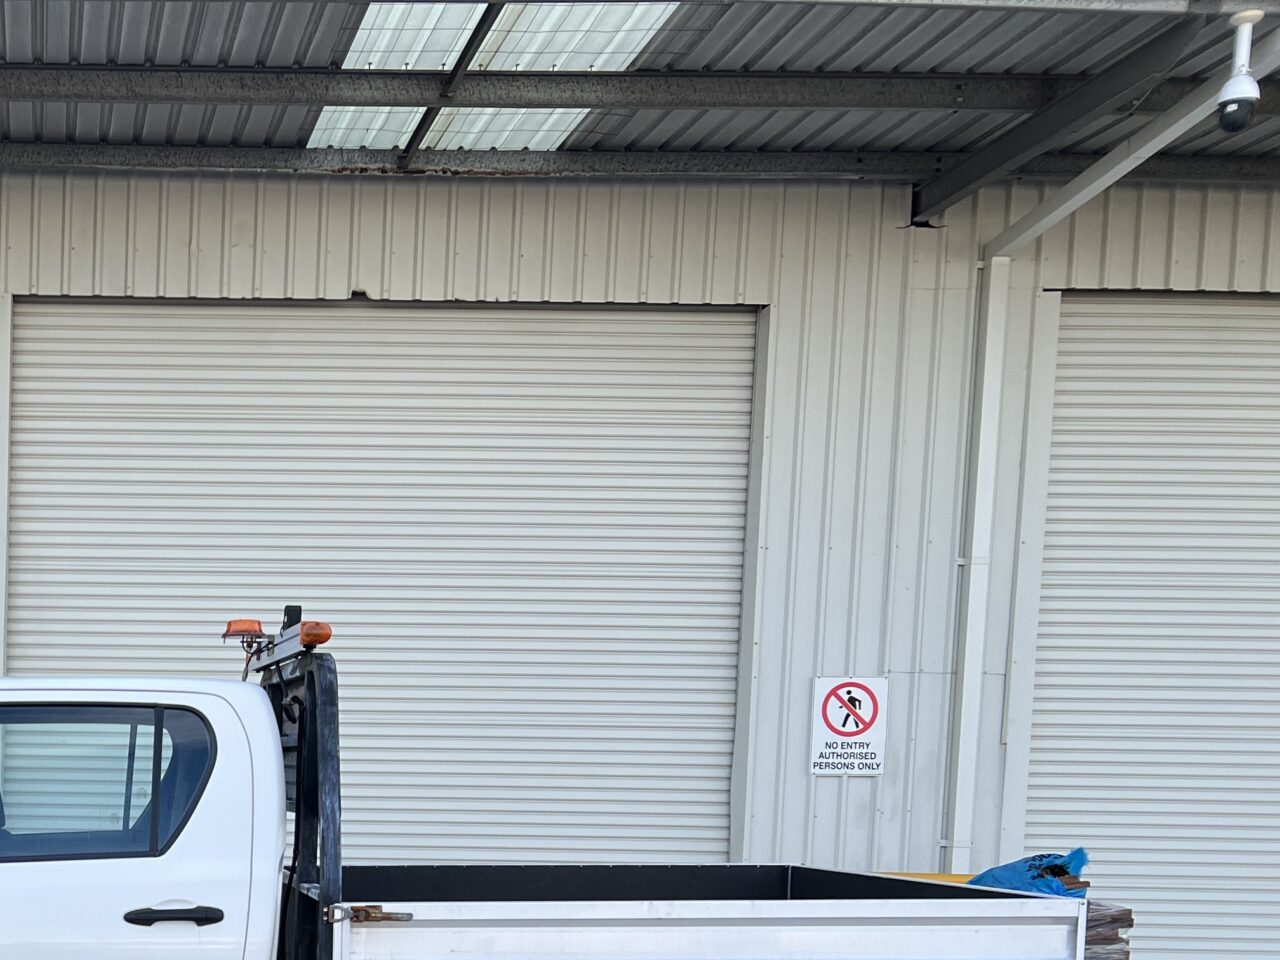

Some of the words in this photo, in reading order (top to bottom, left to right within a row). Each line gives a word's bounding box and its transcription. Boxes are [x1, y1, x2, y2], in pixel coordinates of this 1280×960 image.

[825, 742, 838, 750] NO
[840, 742, 871, 750] ENTRY
[818, 752, 876, 760] AUTHORISED
[813, 762, 856, 770] PERSONS
[857, 762, 882, 770] ONLY
